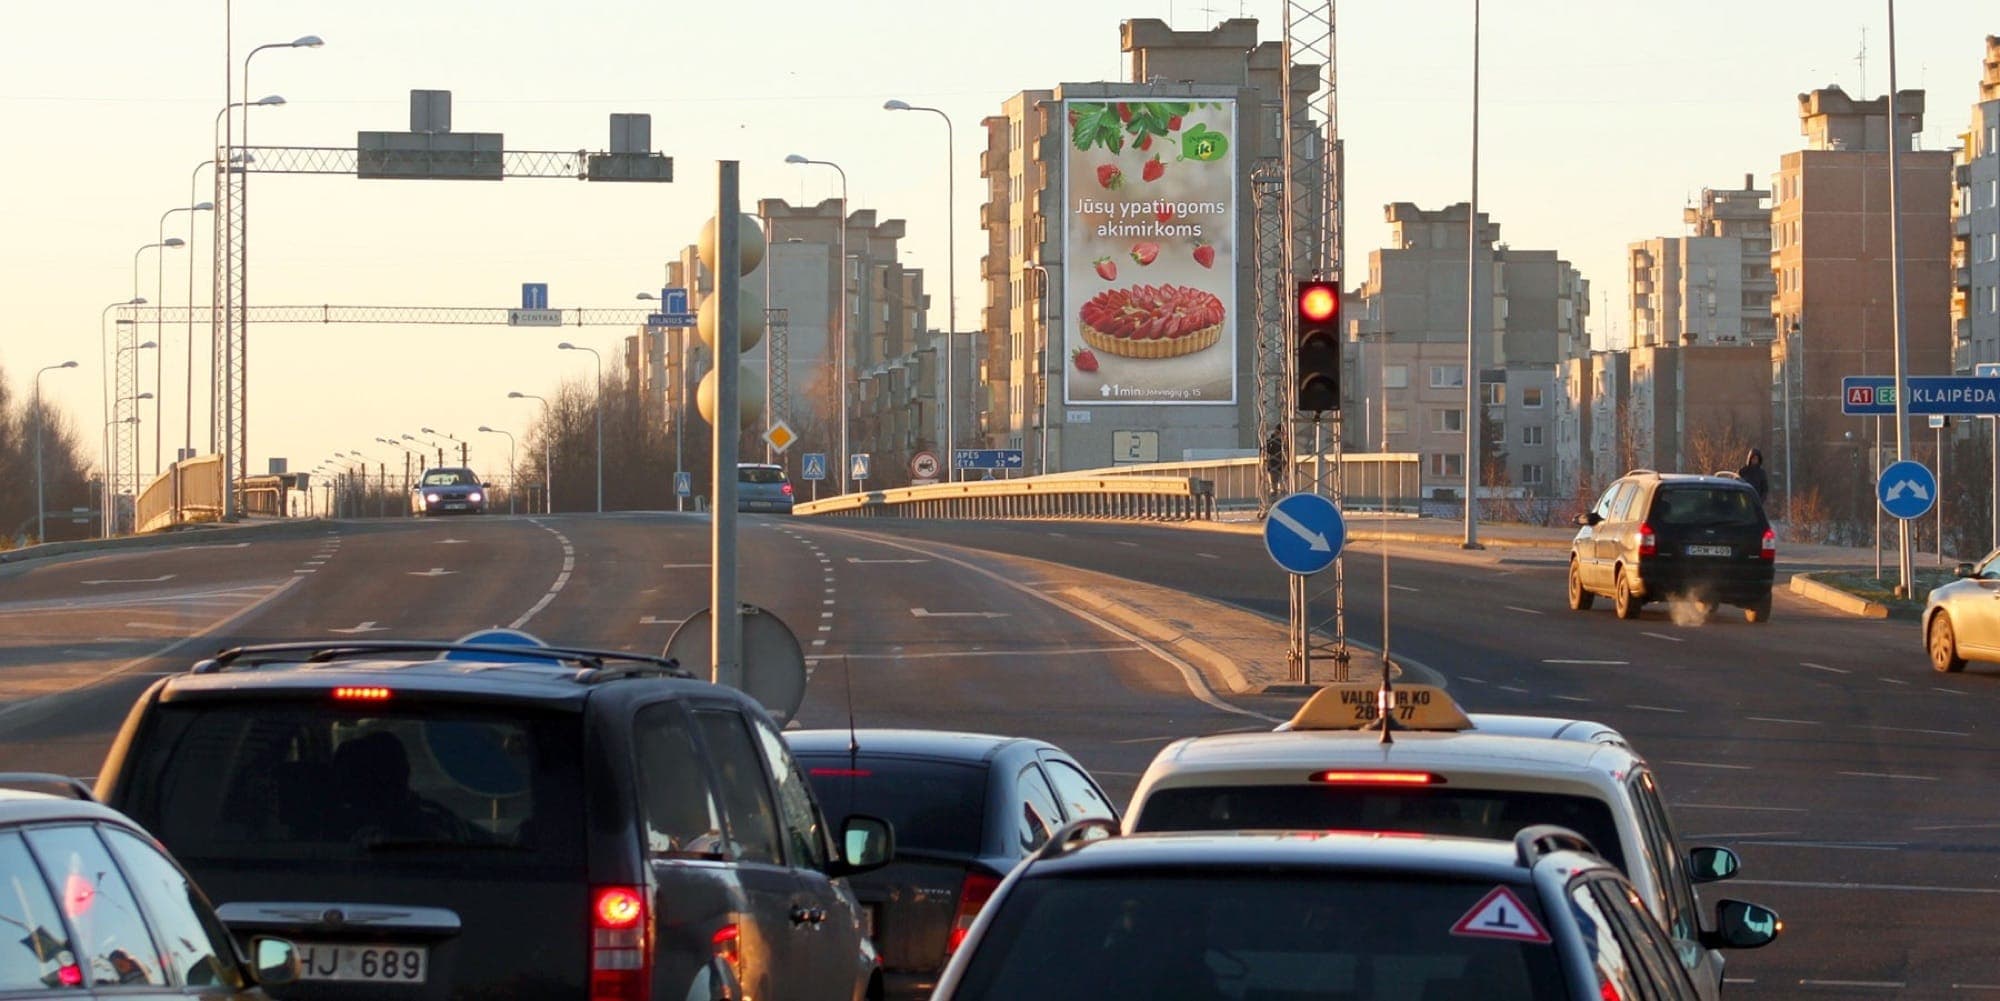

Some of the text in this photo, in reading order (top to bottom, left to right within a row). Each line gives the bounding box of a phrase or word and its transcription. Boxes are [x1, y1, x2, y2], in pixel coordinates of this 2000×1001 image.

[1075, 198, 1225, 218] Jūsų ypatingoms
[1097, 221, 1202, 237] akimirkoms
[521, 314, 559, 322] CENTRAS
[1852, 387, 1996, 403] A1 E8 KLAIPĖDA
[1129, 435, 1140, 458] 2
[1412, 690, 1431, 705] KO
[360, 949, 421, 979] 689
